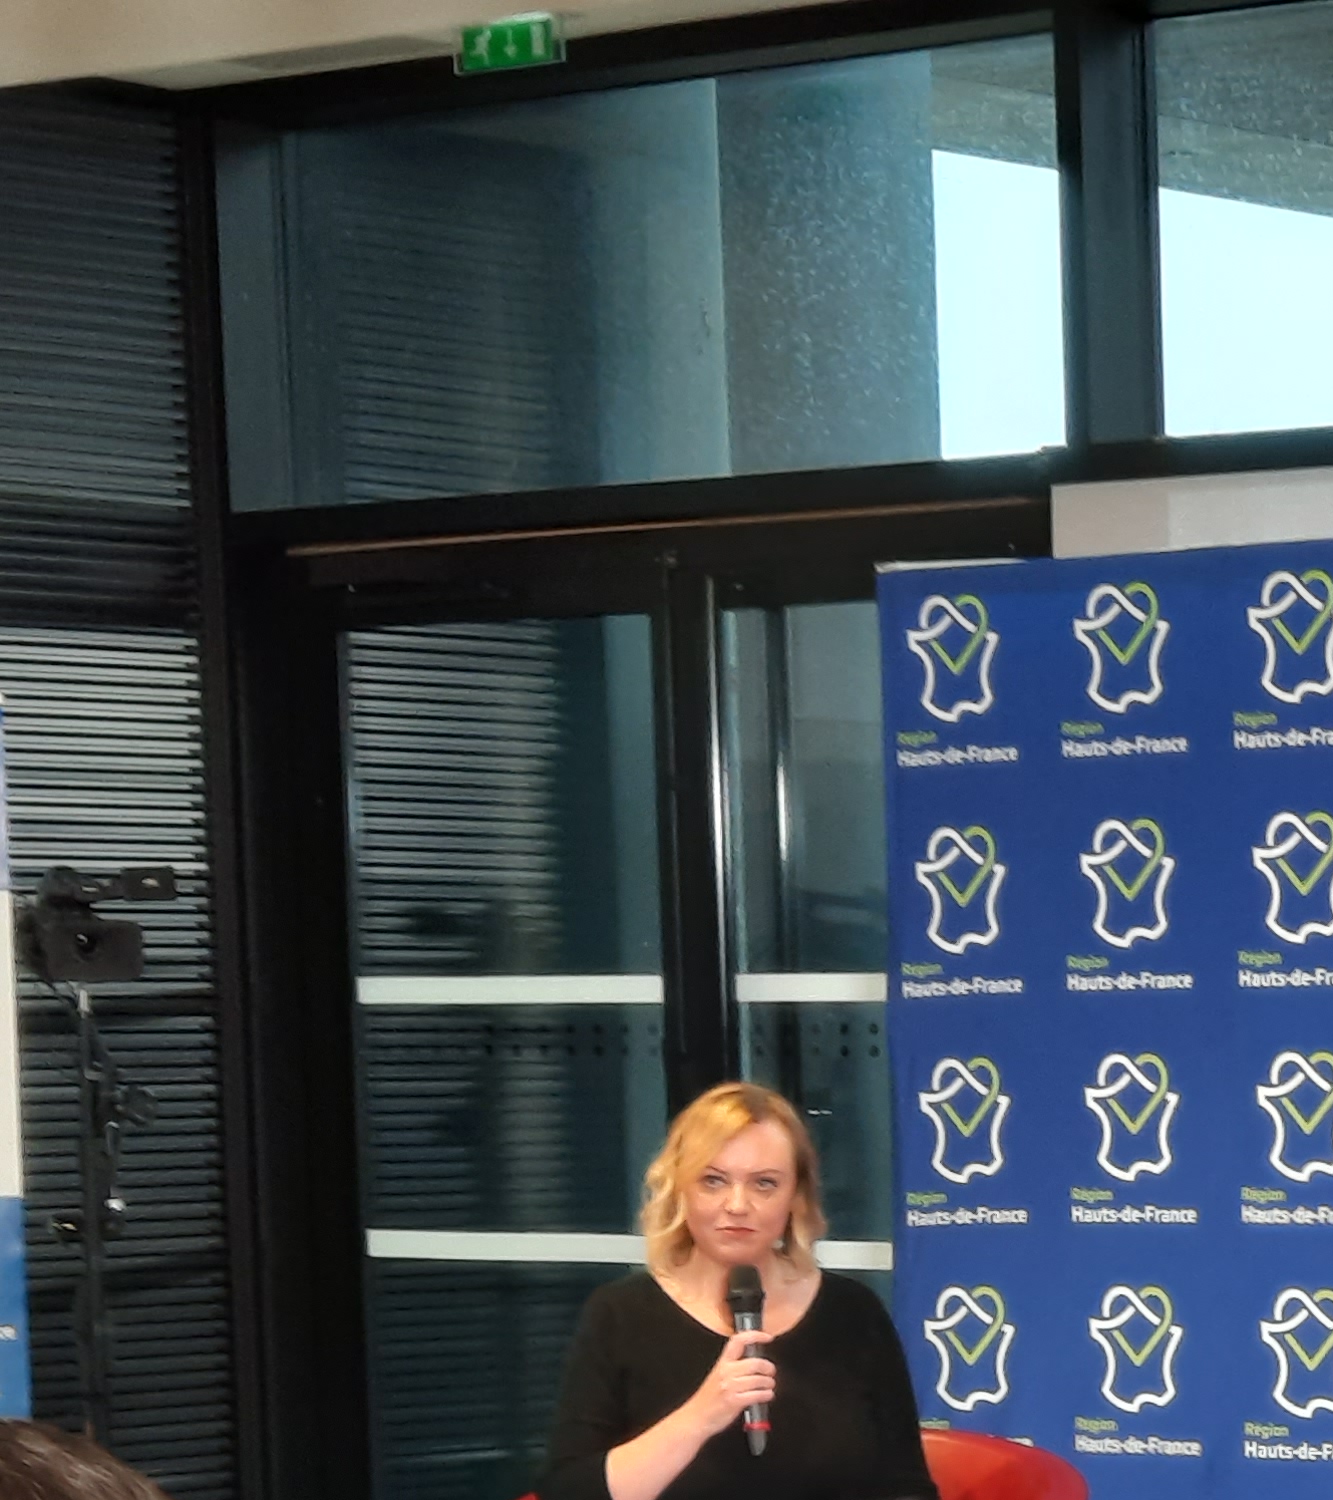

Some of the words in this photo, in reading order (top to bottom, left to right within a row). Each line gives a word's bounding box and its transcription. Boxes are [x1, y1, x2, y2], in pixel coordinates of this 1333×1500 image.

[897, 745, 1018, 767] Hauts-de-France
[1062, 736, 1188, 757] Hauts-de-France
[902, 976, 1023, 998] Hauts-de-France
[1066, 971, 1194, 991] Hauts-de-France
[906, 1206, 1030, 1227] Hauts-de-France
[1071, 1205, 1199, 1224] Hauts-de-France
[1073, 1431, 1203, 1457] Hauts-de-France
